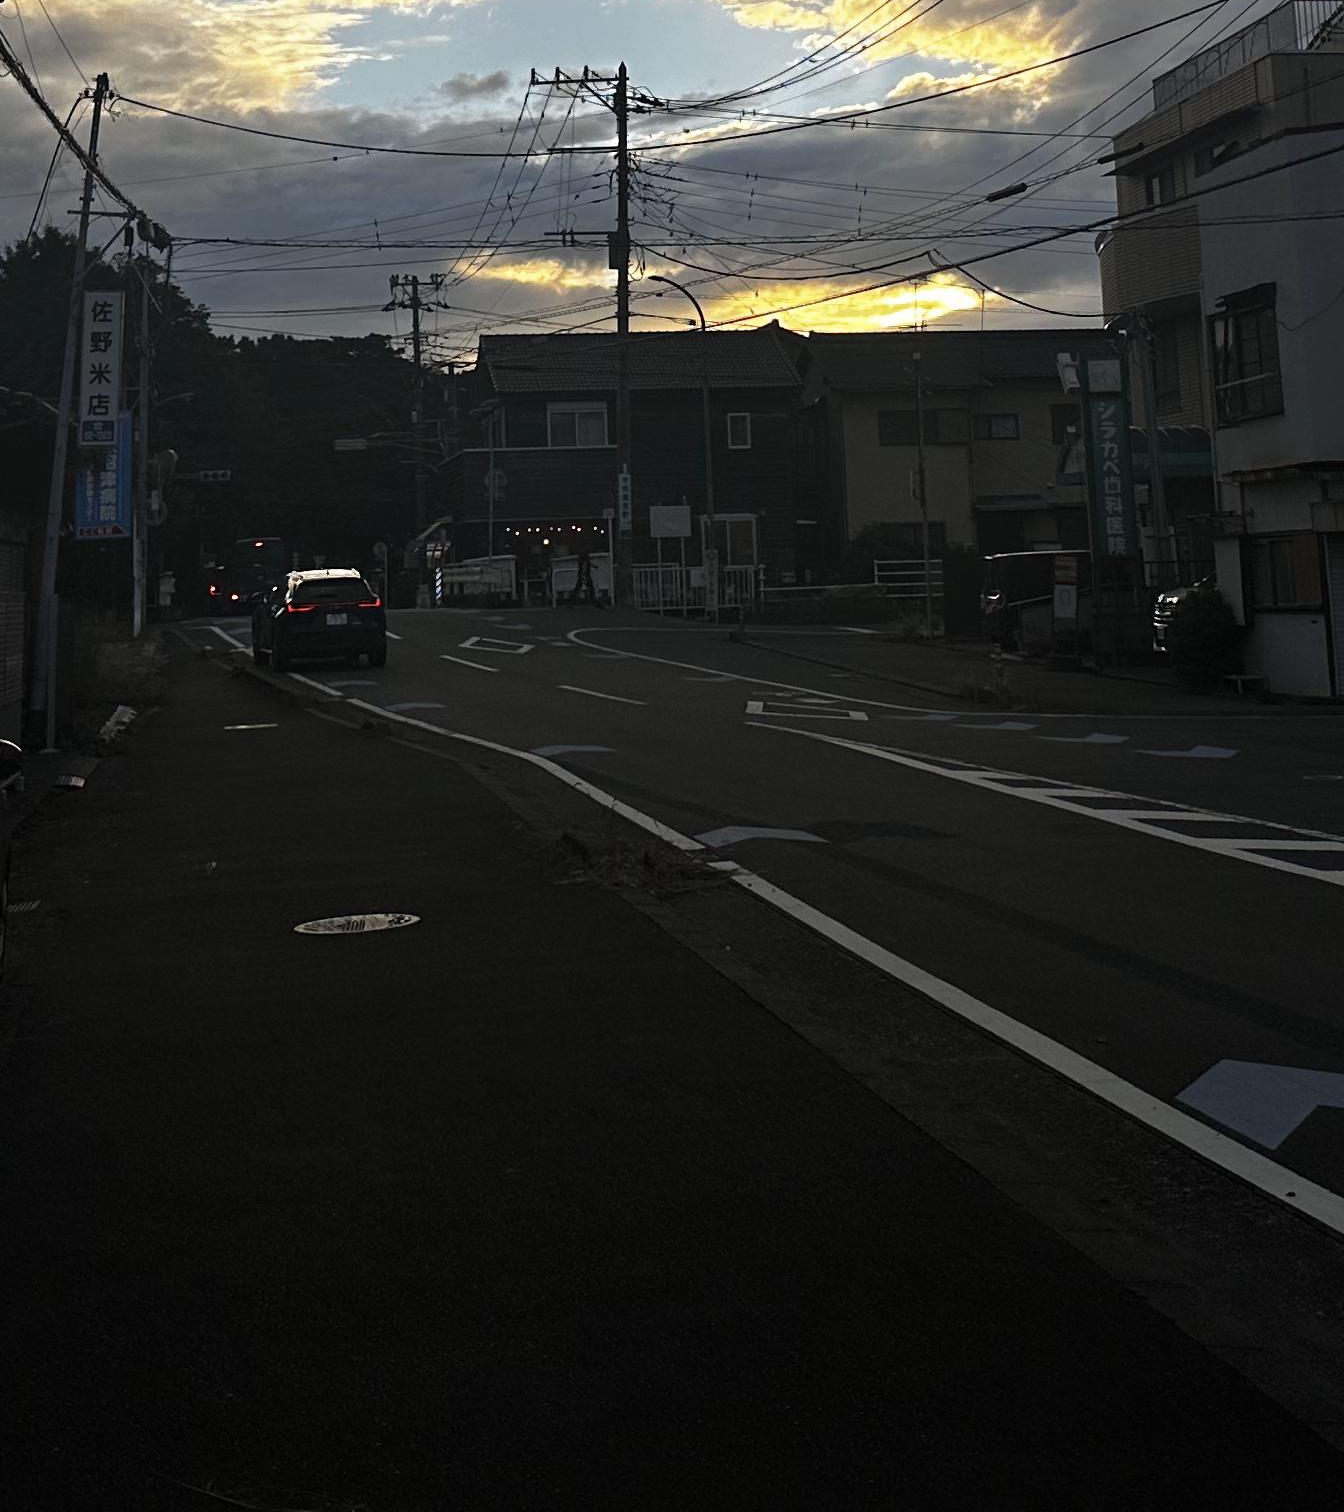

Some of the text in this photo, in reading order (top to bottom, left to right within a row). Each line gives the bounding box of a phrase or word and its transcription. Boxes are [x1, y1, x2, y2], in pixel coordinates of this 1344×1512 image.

[88, 301, 114, 416] 佐野米店
[1099, 401, 1127, 557] シラカベ歯科医院
